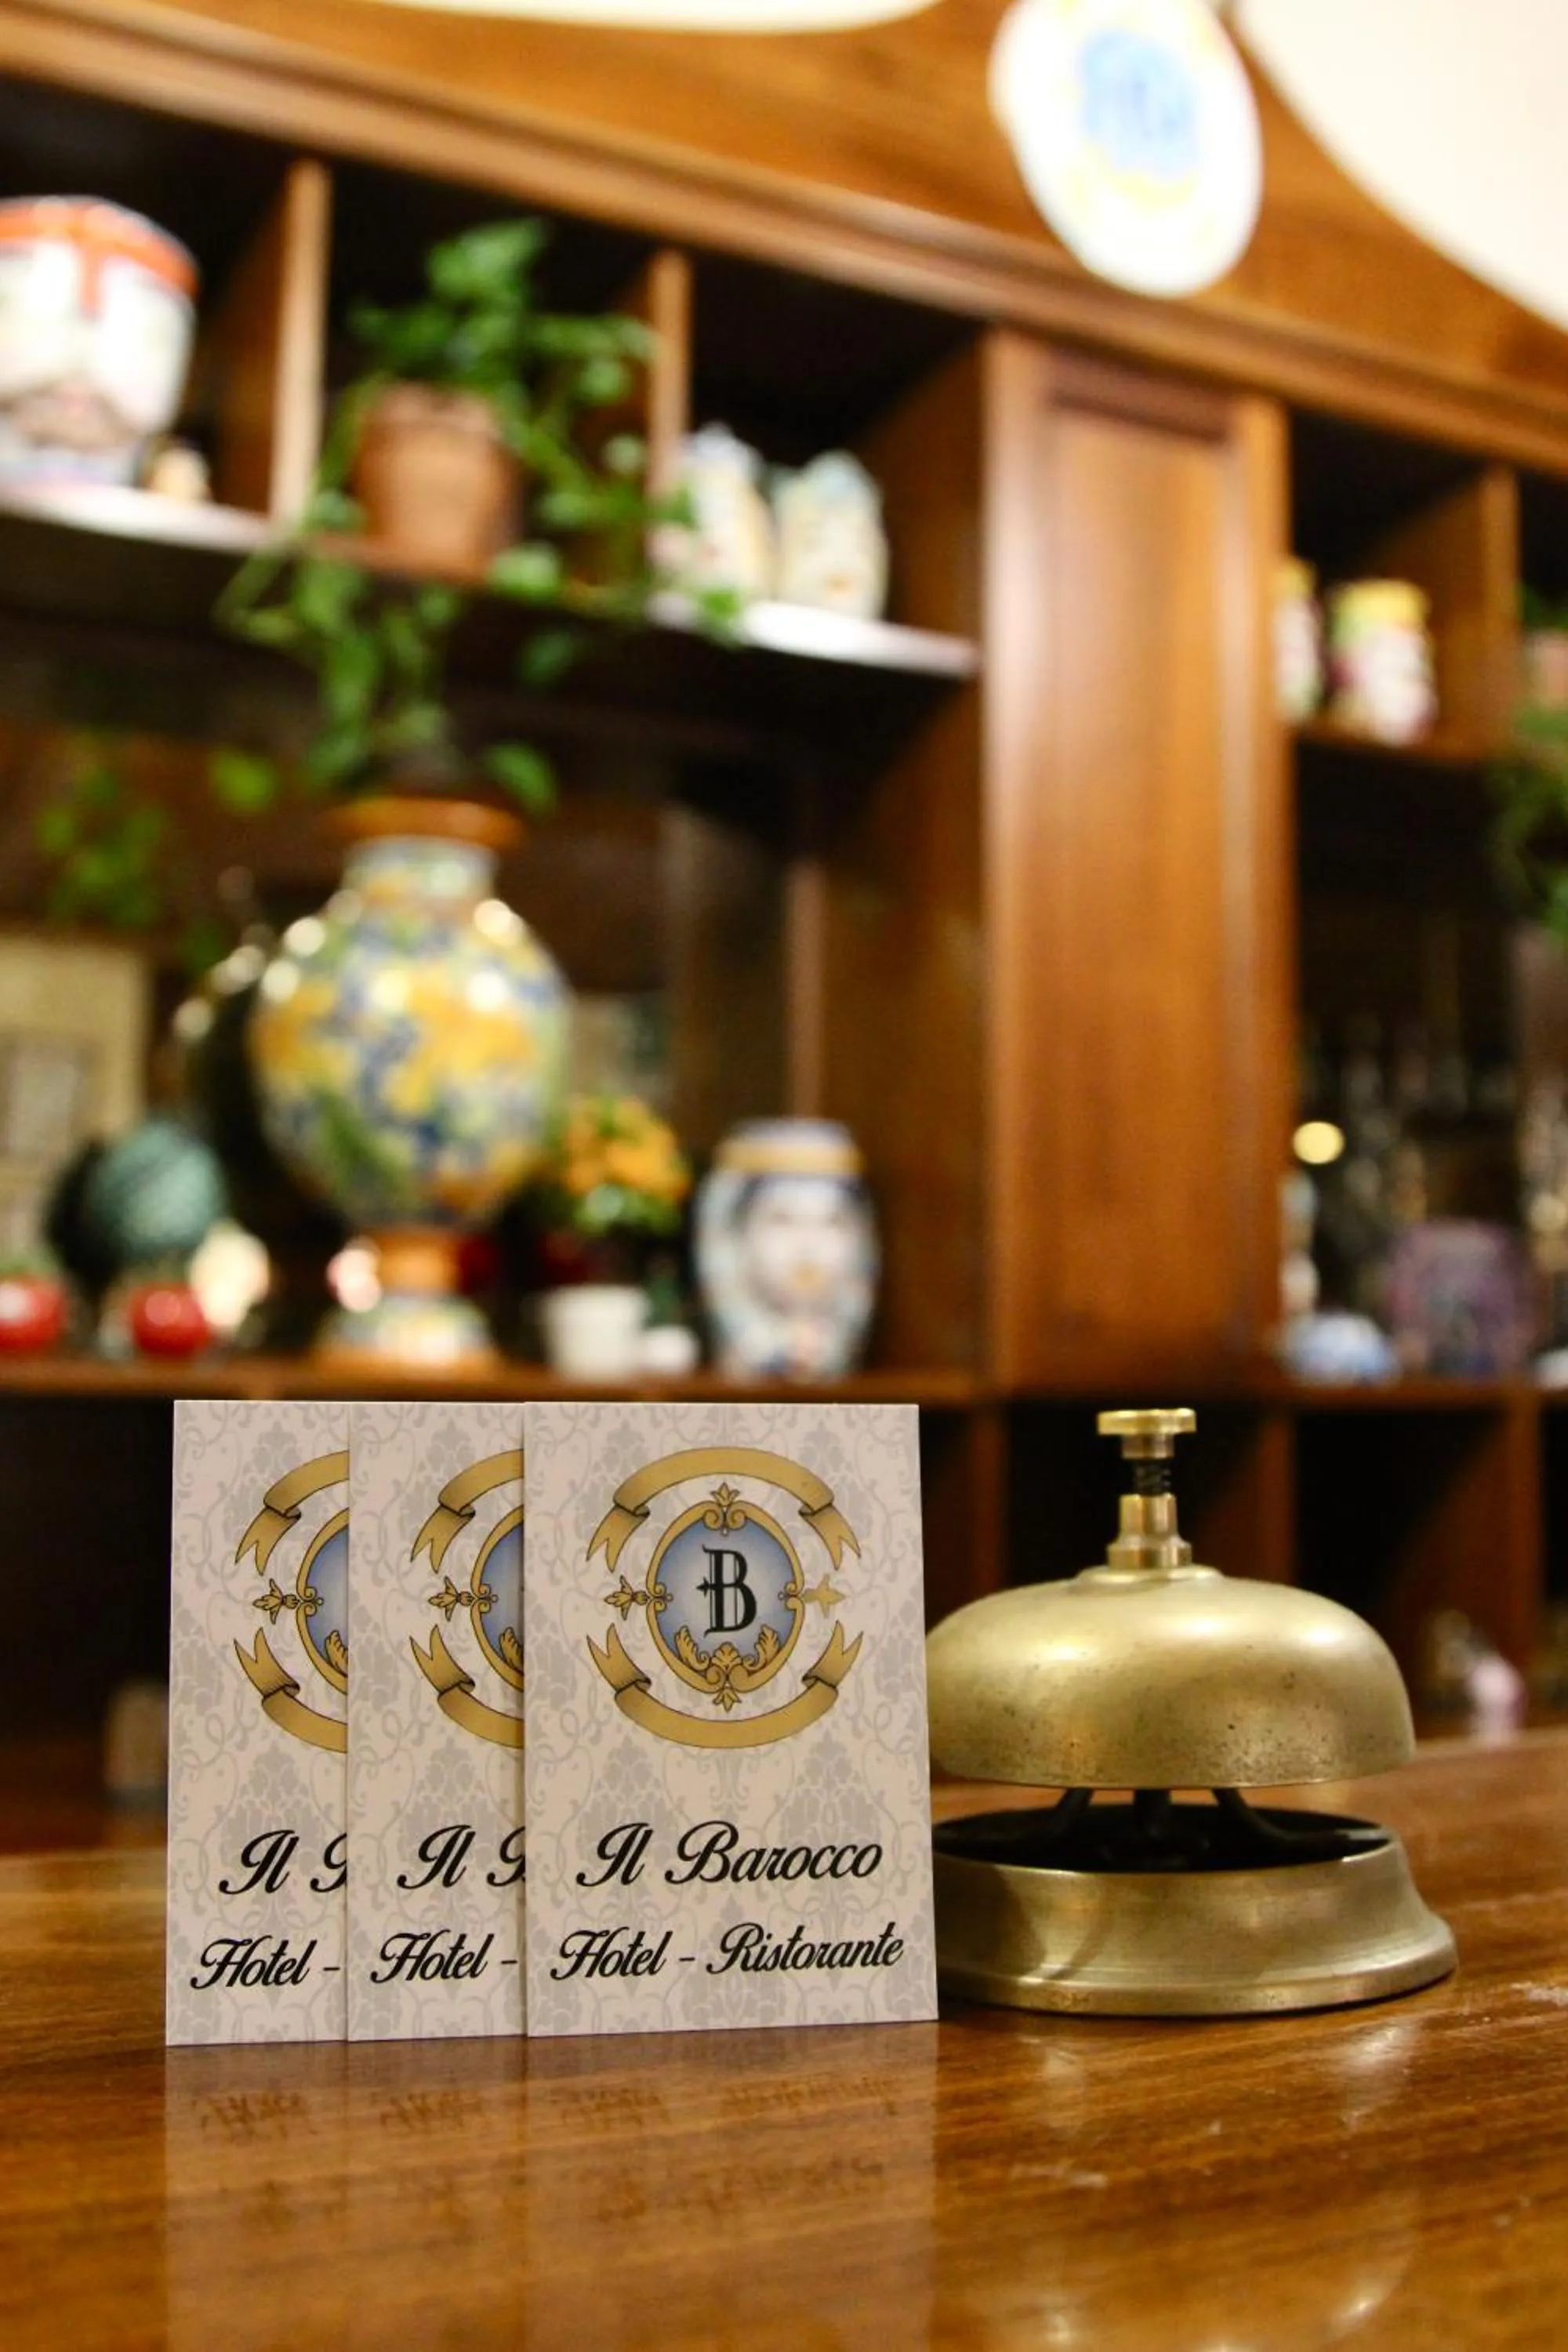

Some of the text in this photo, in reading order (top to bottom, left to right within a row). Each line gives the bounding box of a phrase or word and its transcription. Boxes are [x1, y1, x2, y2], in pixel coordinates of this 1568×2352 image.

[696, 1544, 757, 1637] B
[219, 1830, 299, 1894] Il
[397, 1825, 475, 1889] Il
[576, 1823, 653, 1886] Il
[665, 1821, 883, 1884] Barocco
[191, 1936, 317, 1989] Hotel
[371, 1929, 494, 1984] Hotel
[550, 1927, 673, 1980] Hotel
[706, 1922, 904, 1974] Ristorante
